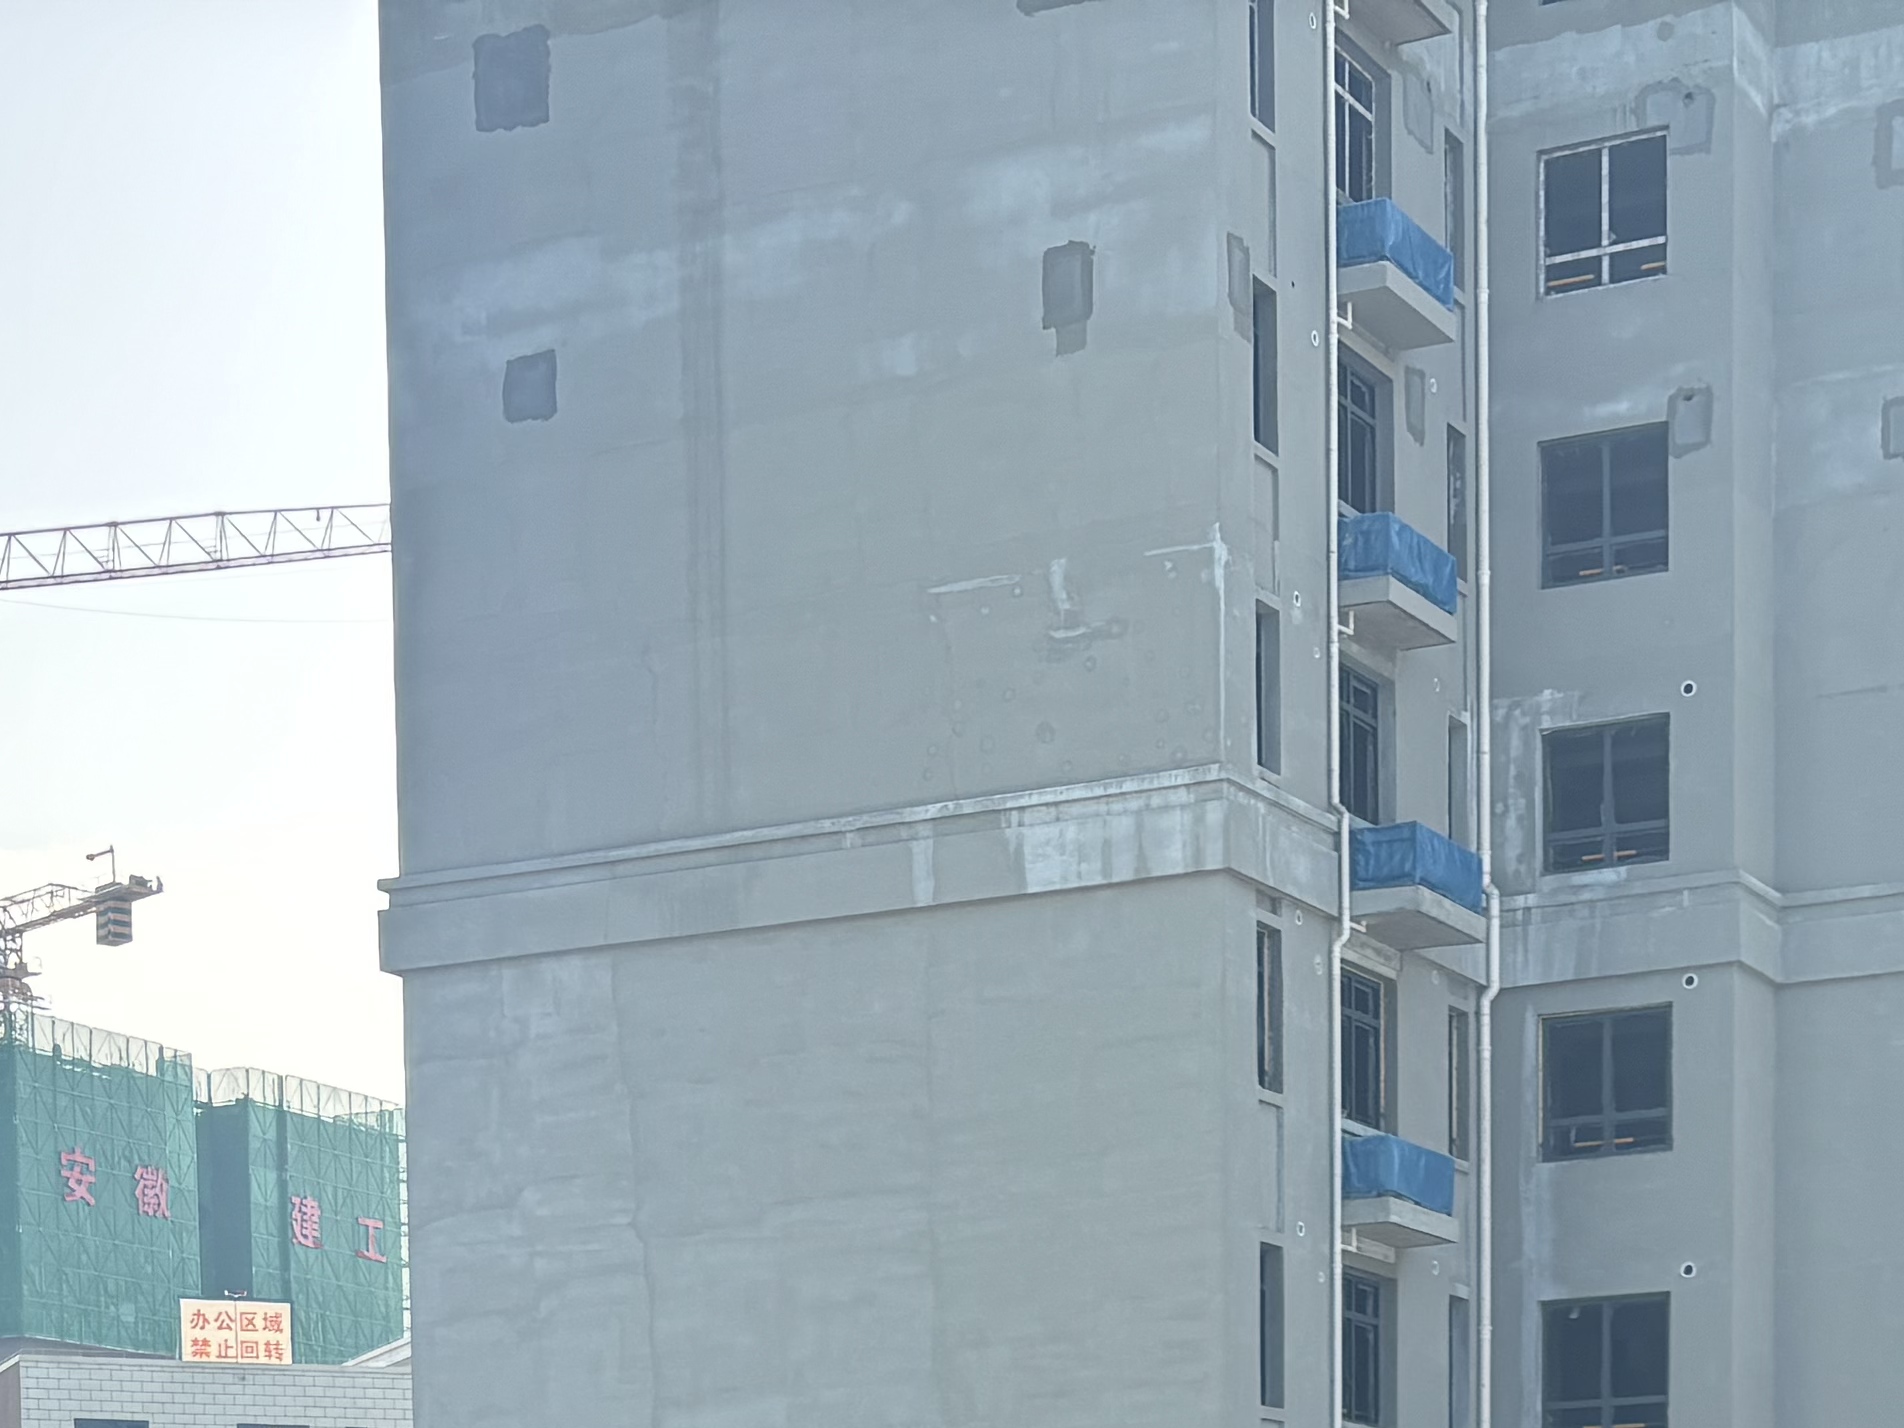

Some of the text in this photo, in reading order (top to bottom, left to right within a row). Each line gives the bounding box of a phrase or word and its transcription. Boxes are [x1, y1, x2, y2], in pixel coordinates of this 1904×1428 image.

[190, 1309, 284, 1335] 办公区域
[191, 1337, 285, 1362] 禁止回转
